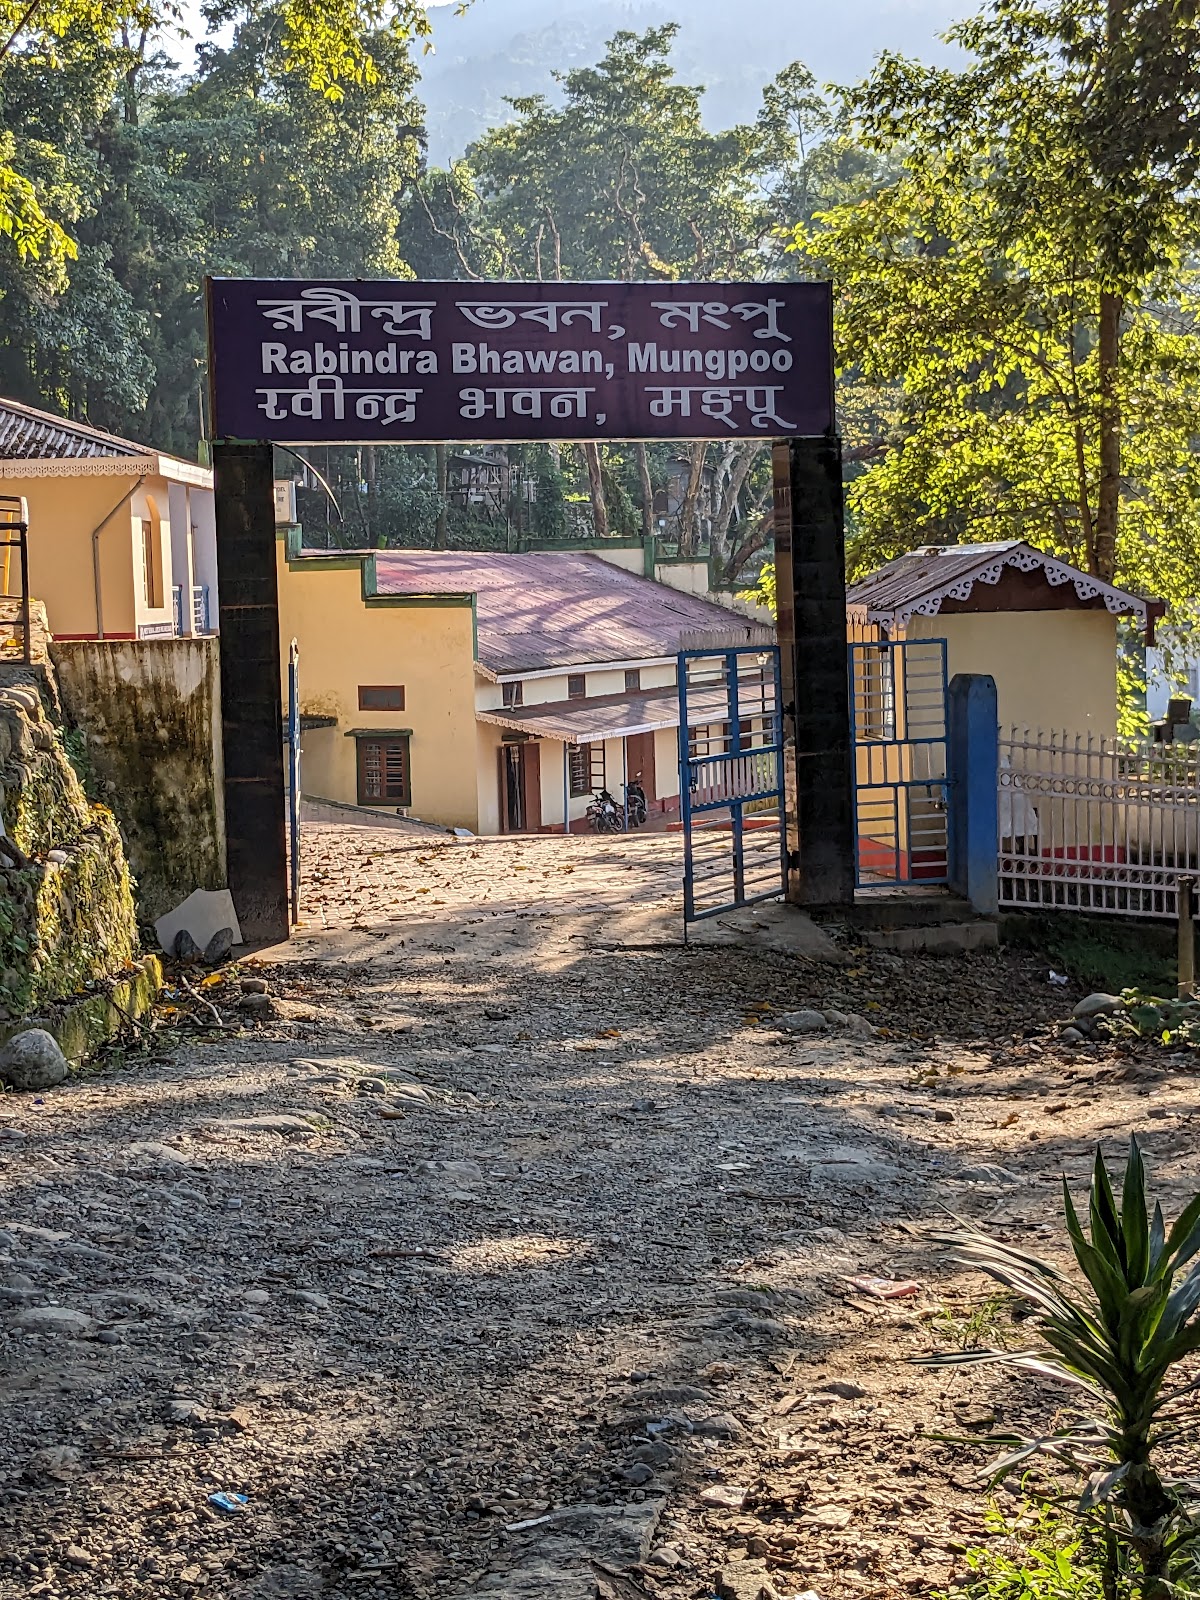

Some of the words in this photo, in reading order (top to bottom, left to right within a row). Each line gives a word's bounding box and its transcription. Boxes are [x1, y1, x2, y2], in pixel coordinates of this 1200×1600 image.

[257, 287, 437, 340] রবীন্দ্র
[455, 301, 626, 340] ভবন,
[651, 299, 792, 342] মংপু
[262, 342, 438, 374] Rabindra
[452, 342, 614, 380] Bhawan,
[628, 342, 793, 380] Mungpoo
[255, 375, 423, 425] रवीन्द्र
[458, 387, 606, 425] भवन,
